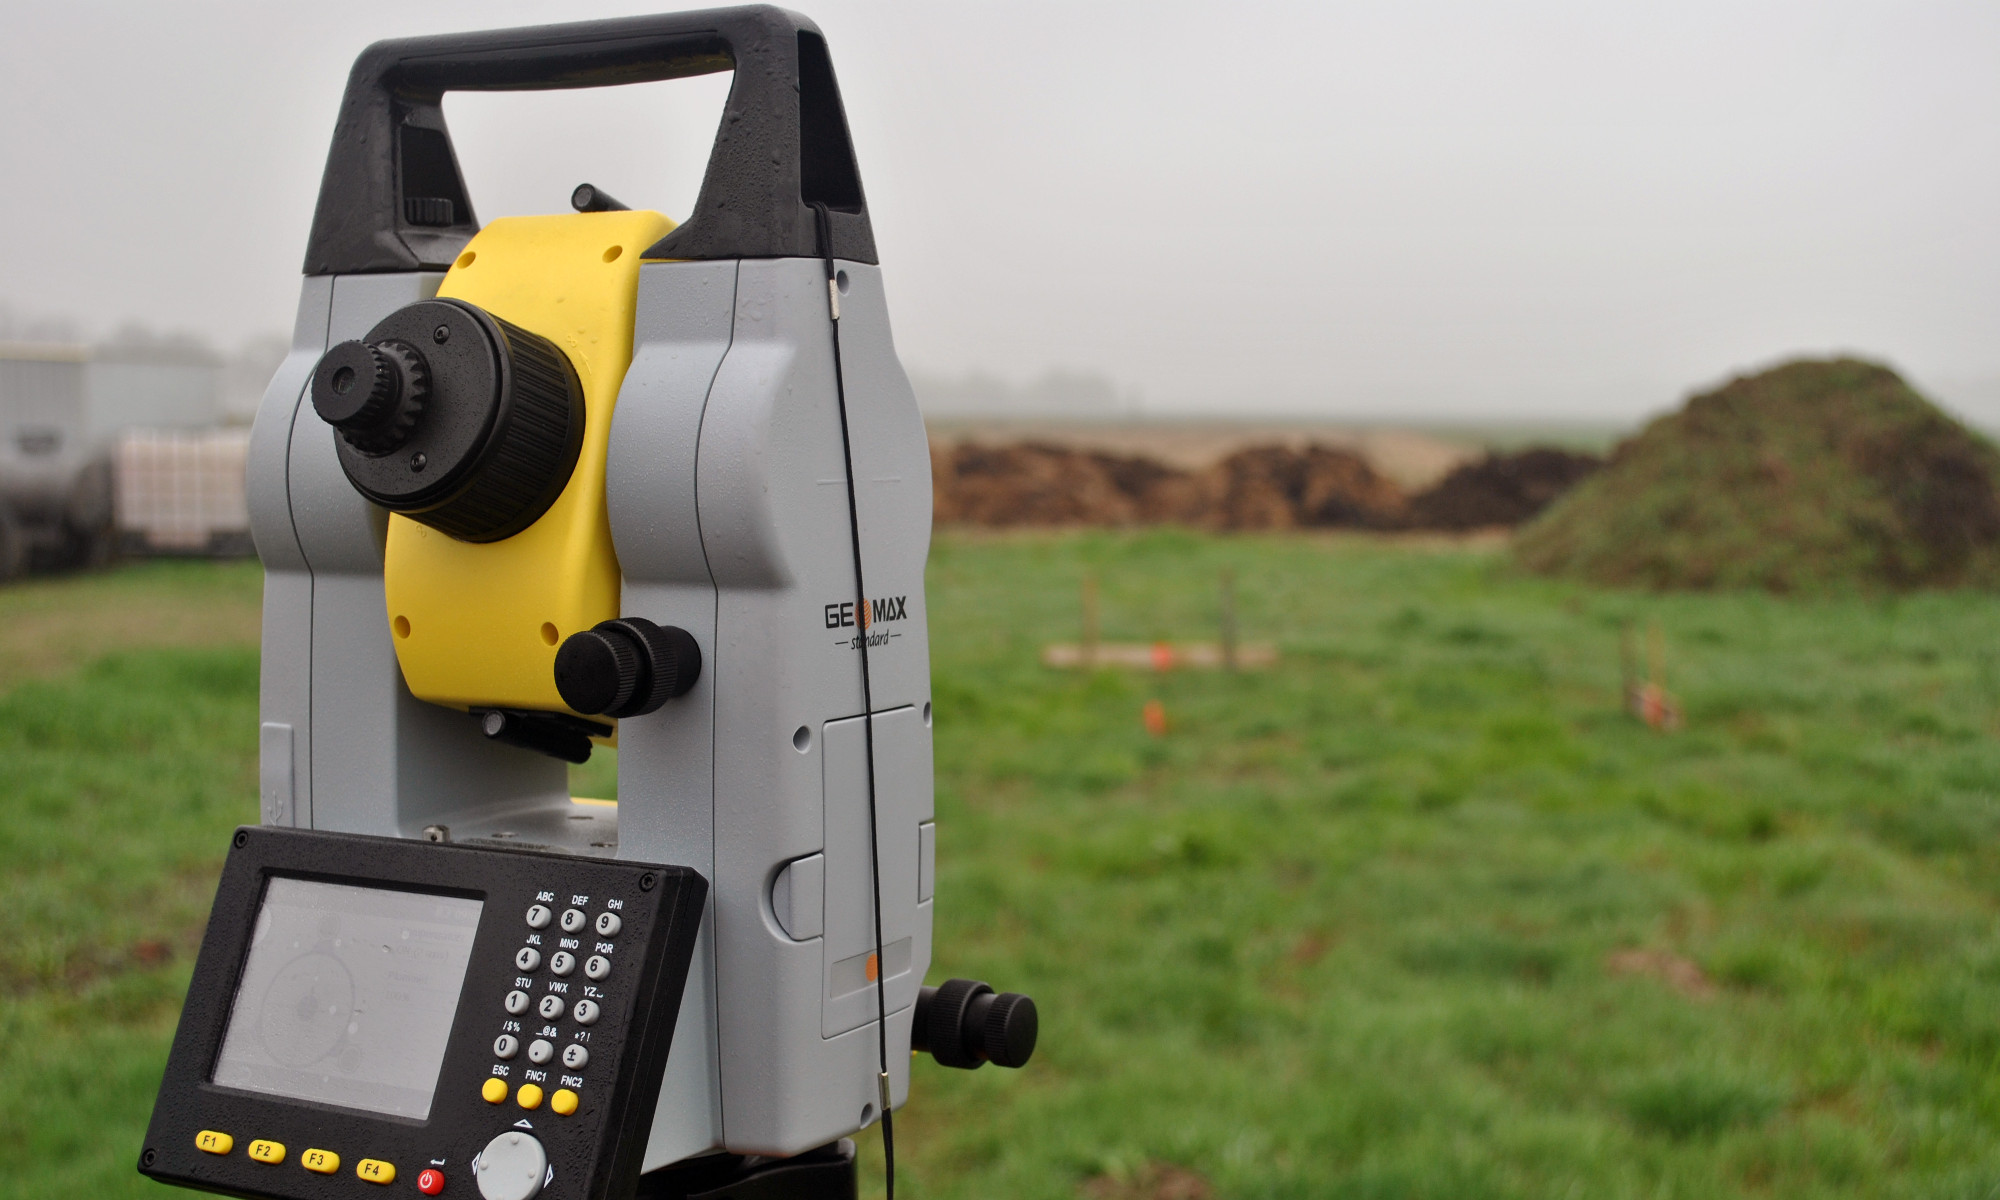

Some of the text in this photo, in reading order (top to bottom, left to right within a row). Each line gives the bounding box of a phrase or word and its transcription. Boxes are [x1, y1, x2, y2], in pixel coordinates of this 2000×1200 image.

[536, 891, 555, 902] ABC
[571, 895, 589, 906] DEF
[607, 899, 624, 910] GHI
[531, 908, 540, 921] 7
[565, 912, 574, 925] 8
[601, 916, 609, 928] 9
[526, 934, 542, 945] JKL
[559, 938, 579, 949] MNO
[595, 942, 613, 954] PQR
[520, 951, 529, 964] 4
[555, 955, 564, 968] 5
[590, 959, 598, 972] 6
[515, 977, 532, 988] STU
[549, 981, 569, 993] VWX
[511, 994, 518, 1007] 1
[544, 998, 553, 1012] 2
[578, 1003, 587, 1016] 3
[499, 1038, 507, 1051] 0
[492, 1064, 510, 1076] ESC
[525, 1069, 547, 1082] FNC1
[561, 1075, 583, 1087] FNC2
[202, 1135, 217, 1148] F1
[255, 1144, 271, 1157] F2
[309, 1153, 324, 1166] F3
[364, 1163, 380, 1176] F4
